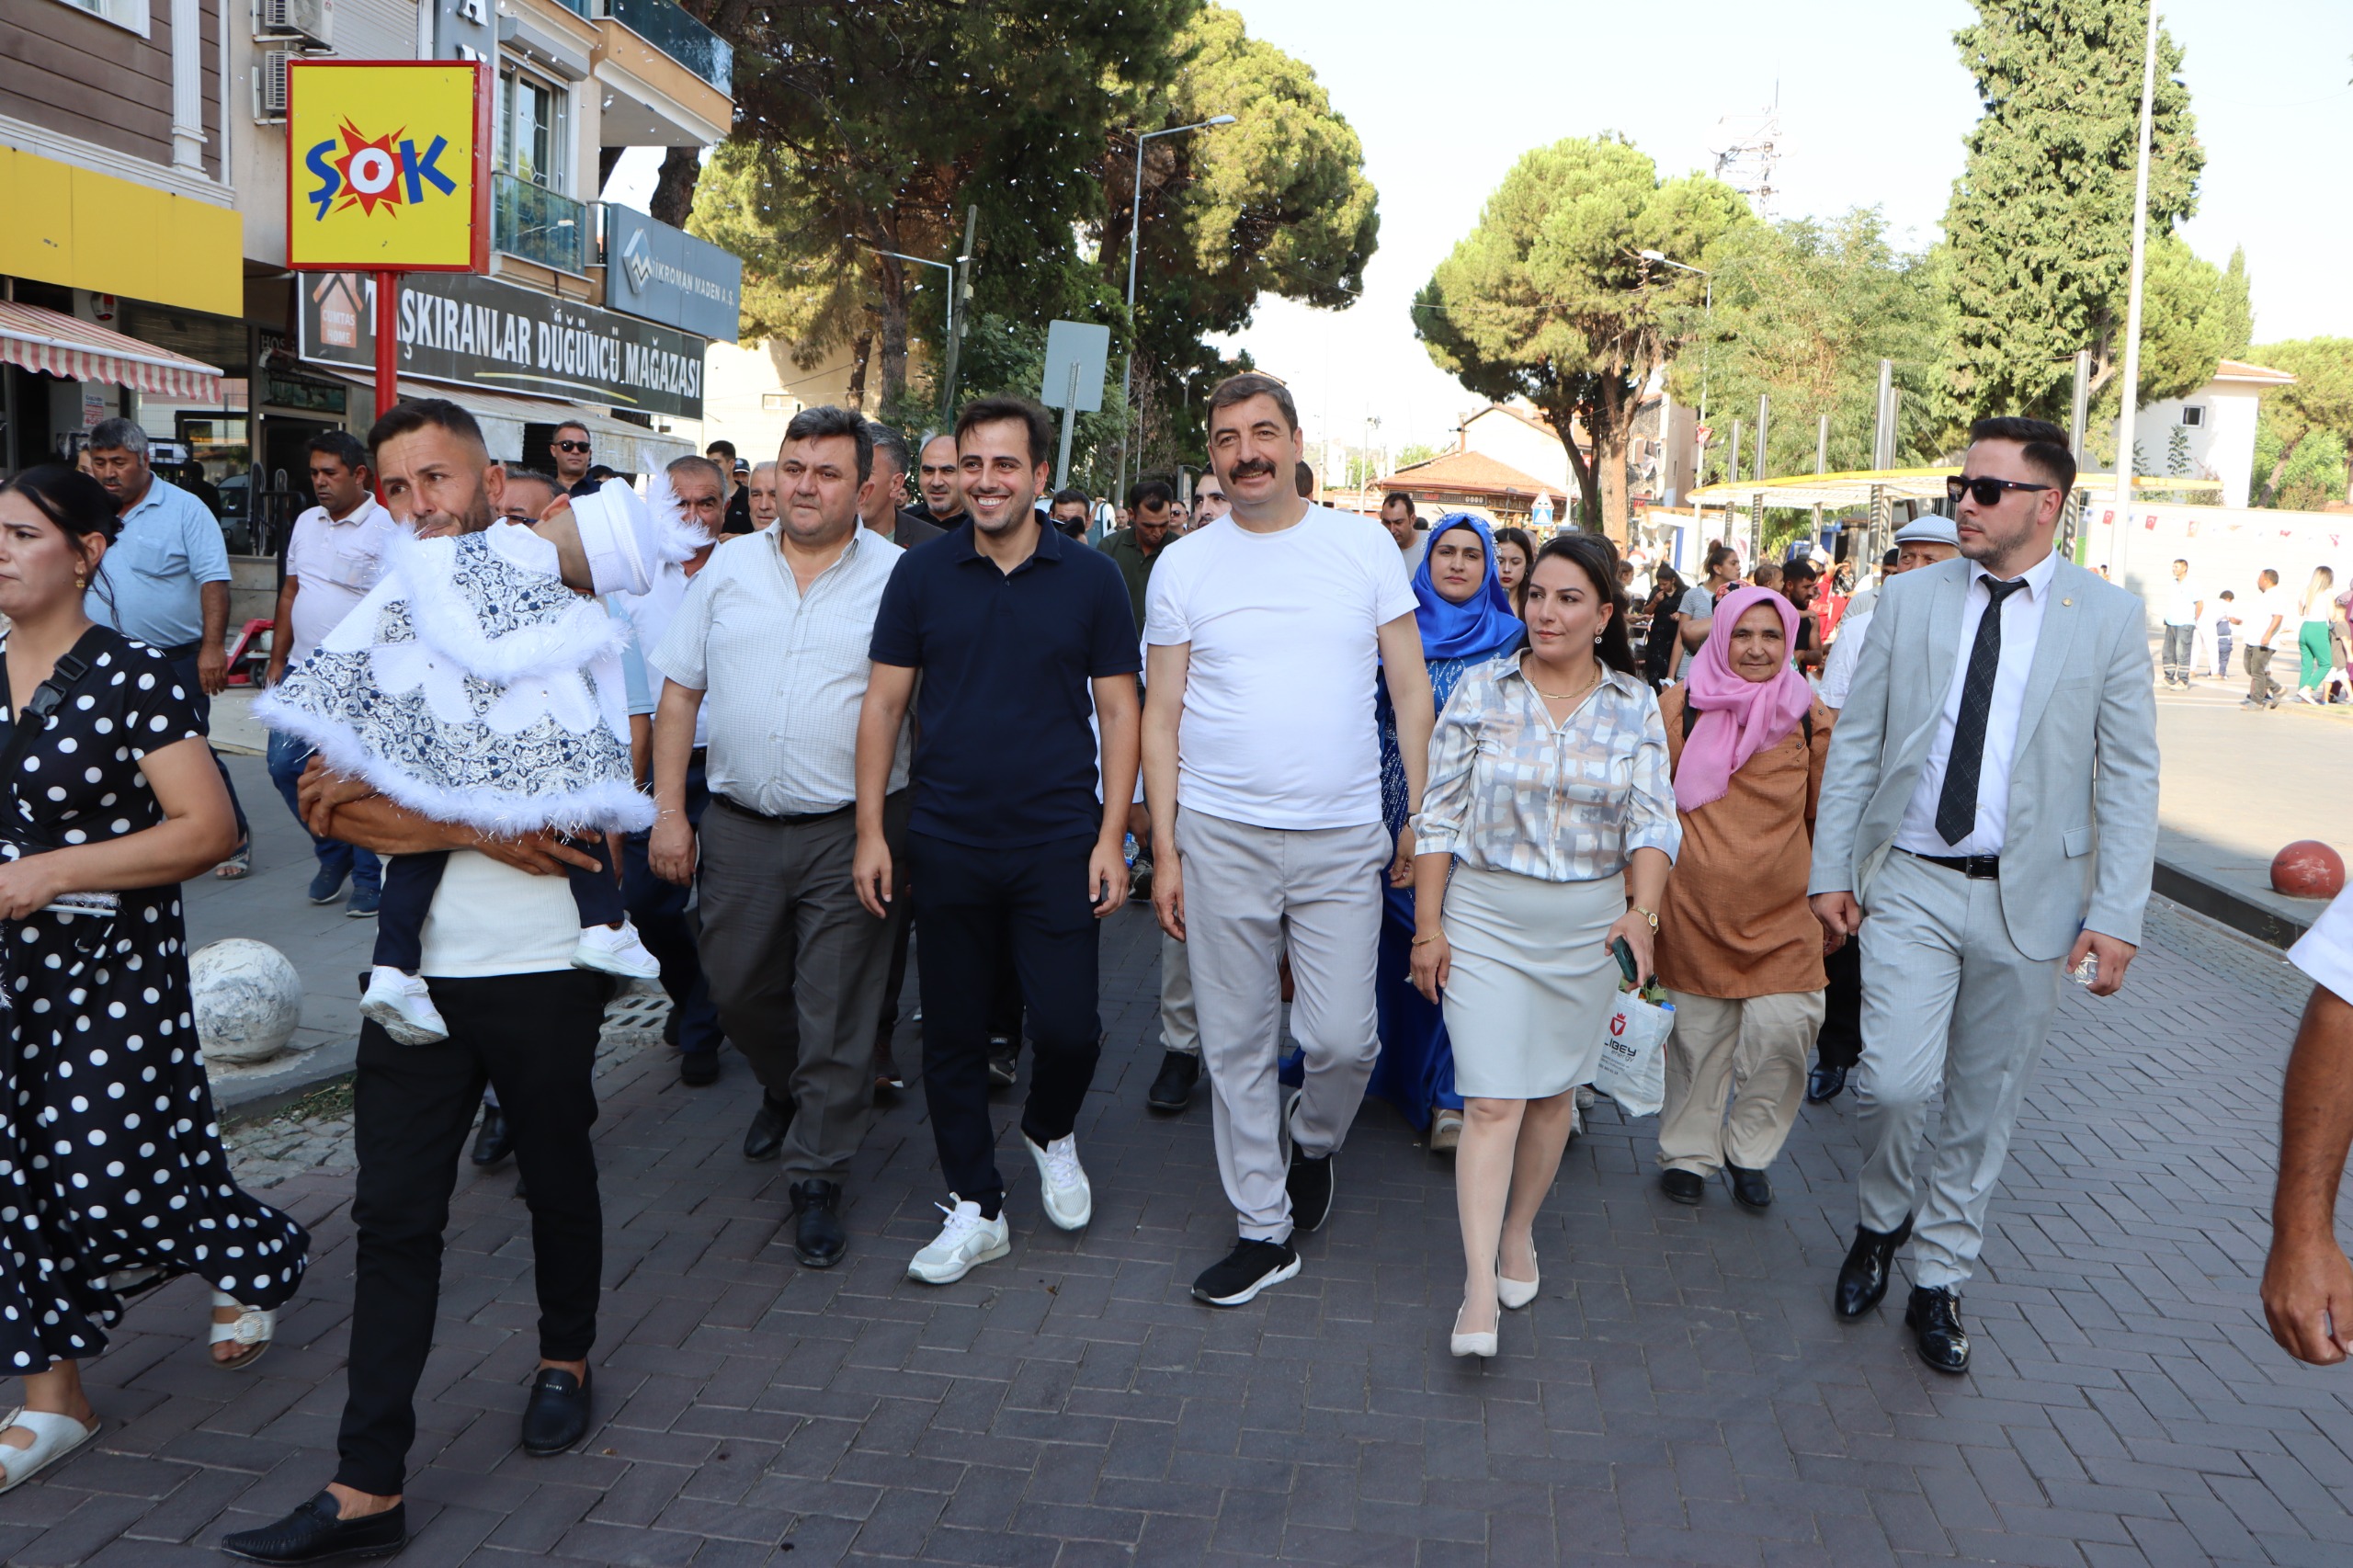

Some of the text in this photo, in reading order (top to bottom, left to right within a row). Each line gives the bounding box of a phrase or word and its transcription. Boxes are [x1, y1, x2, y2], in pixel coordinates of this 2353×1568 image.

[695, 277, 720, 301] MADEN
[326, 329, 351, 344] HOME
[365, 278, 701, 399] TŞKIRANLAR DÜĞÜNCÜ MAĞAZASI
[1611, 1050, 1634, 1062] energy
